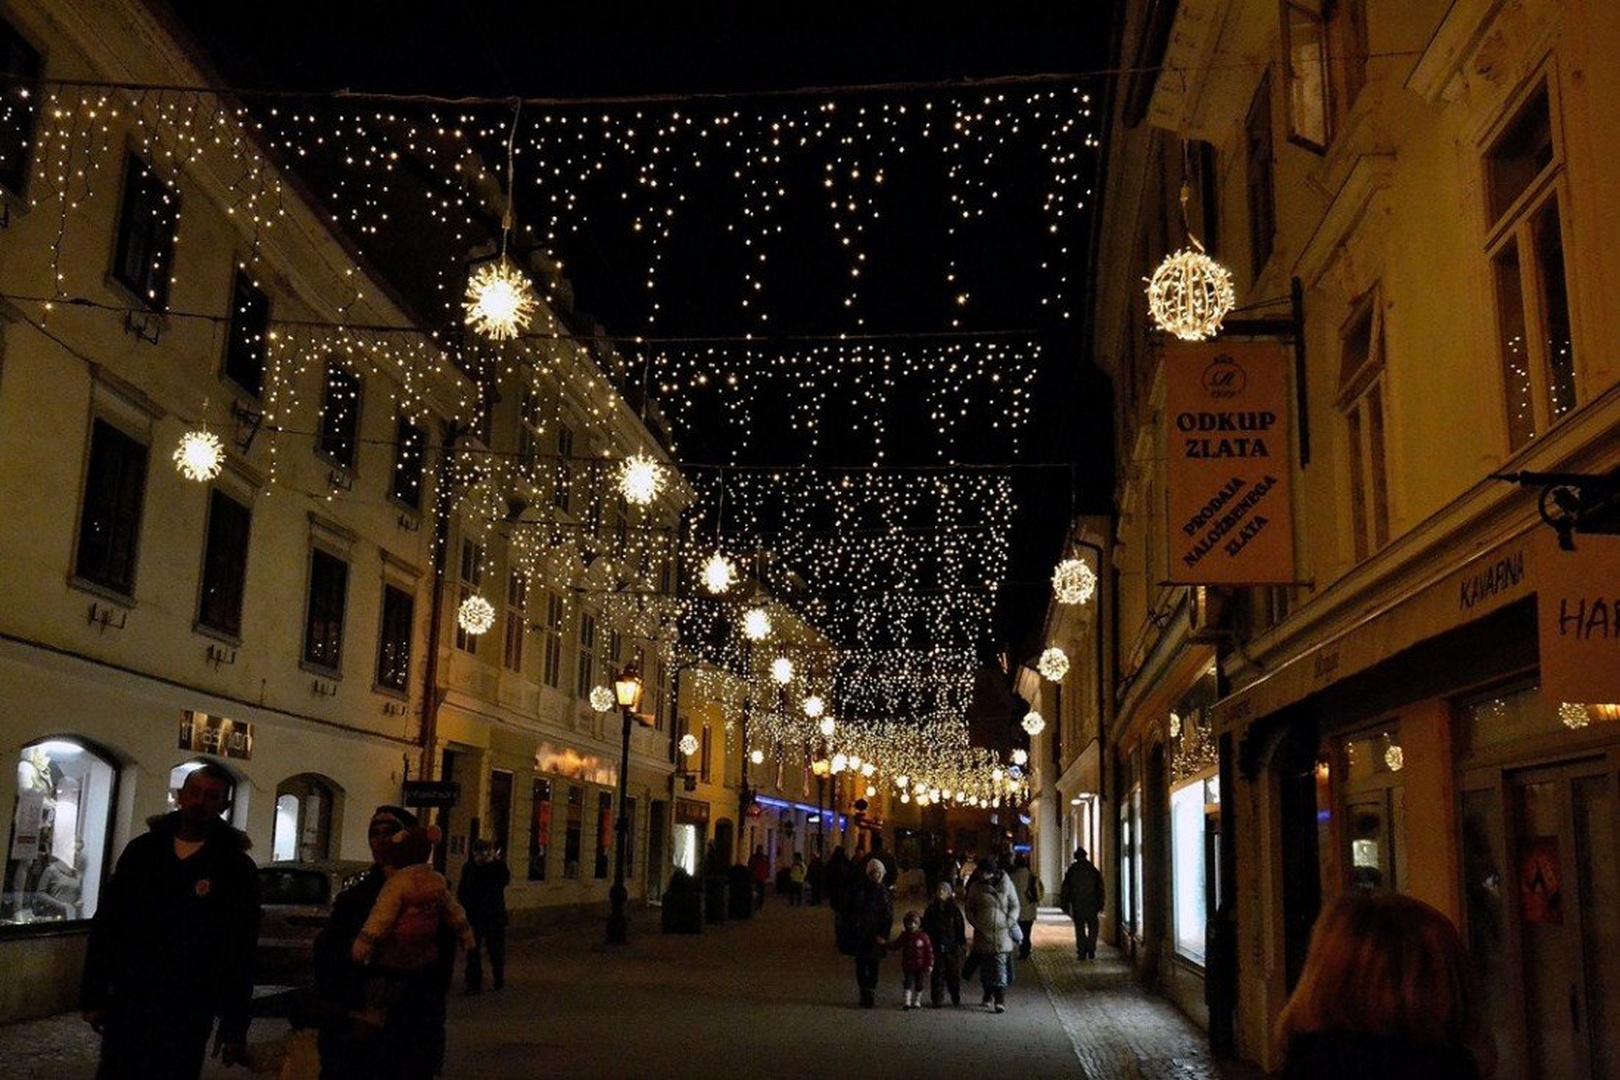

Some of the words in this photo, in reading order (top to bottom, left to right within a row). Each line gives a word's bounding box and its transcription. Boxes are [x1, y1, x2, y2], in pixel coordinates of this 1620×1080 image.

[1176, 412, 1276, 432] ODKUP
[1185, 438, 1269, 458] ZLATA
[1183, 477, 1246, 537] PRODAJA
[1223, 515, 1269, 557] ZLATA
[1459, 550, 1525, 611] KAVARNA
[1558, 597, 1620, 640] HA
